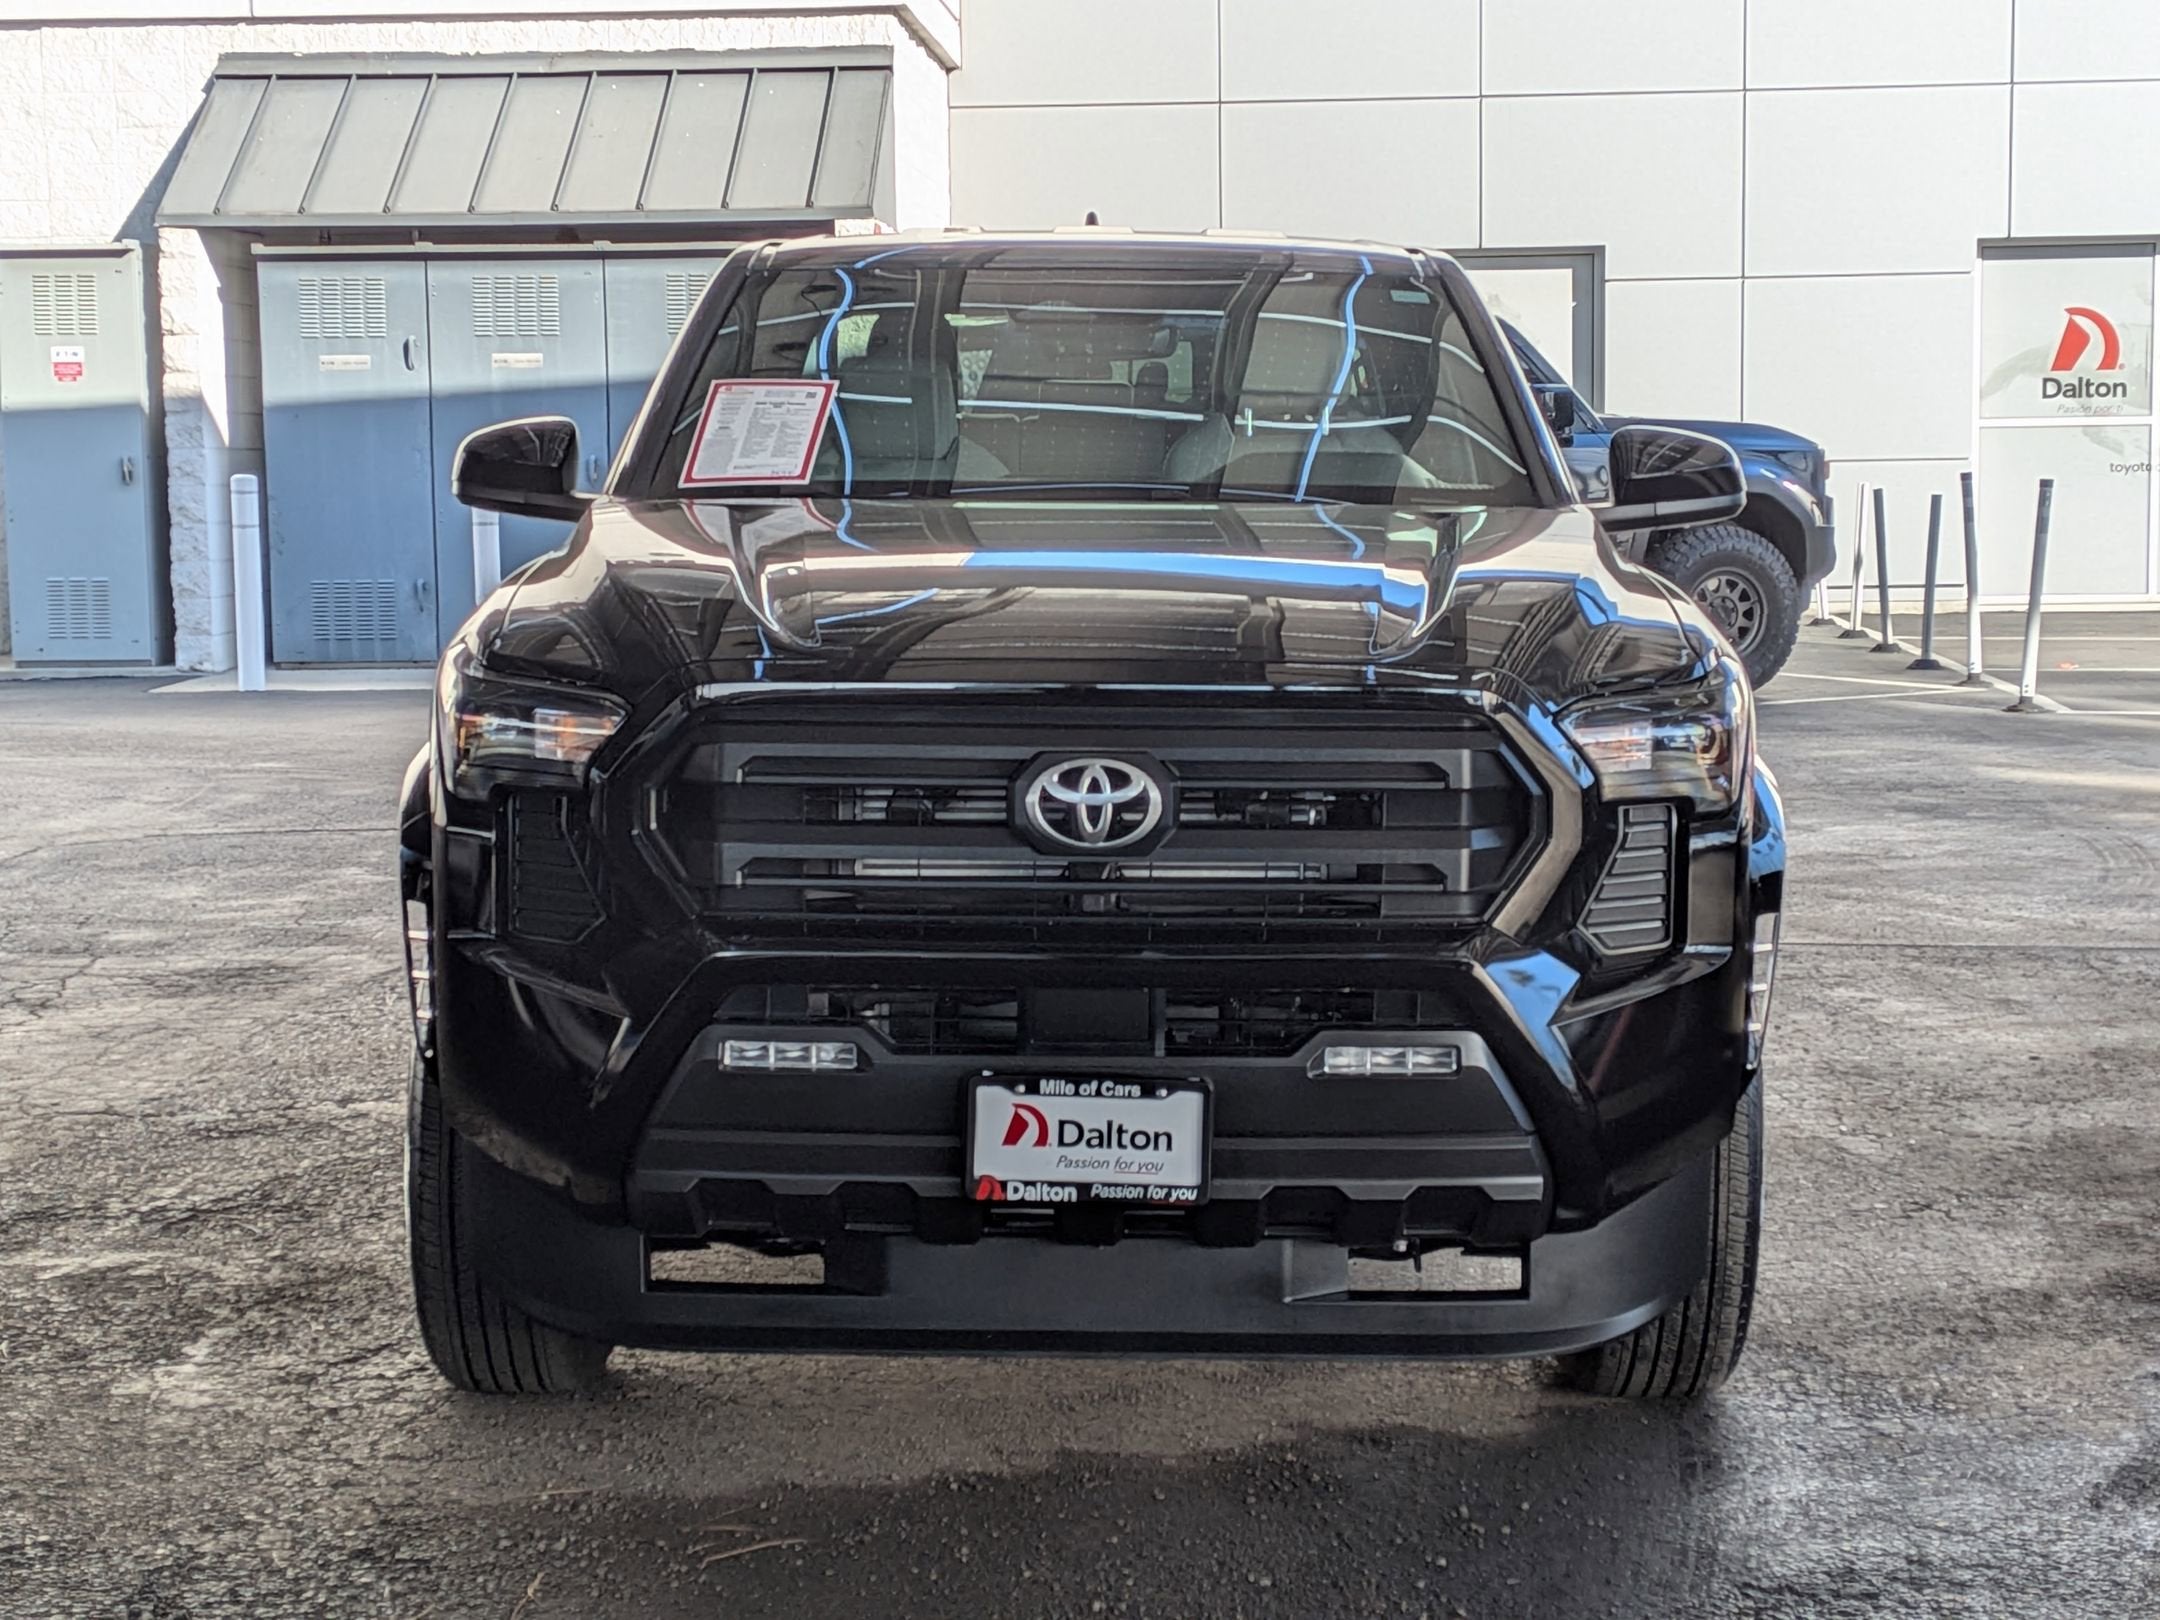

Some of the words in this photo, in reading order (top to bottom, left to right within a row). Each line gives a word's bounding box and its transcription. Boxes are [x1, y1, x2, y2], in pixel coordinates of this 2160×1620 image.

[2042, 377, 2127, 399] Dalton
[1039, 1078, 1076, 1096] Mile
[1078, 1079, 1099, 1097] of
[1100, 1080, 1142, 1098] Cars
[1056, 1119, 1173, 1152] Dalton
[1056, 1155, 1110, 1170] Passion
[1114, 1156, 1134, 1171] for
[1136, 1160, 1164, 1173] you
[1006, 1181, 1078, 1203] Dalton
[1090, 1183, 1144, 1200] Passion
[1146, 1184, 1168, 1200] for
[1170, 1187, 1198, 1203] you
